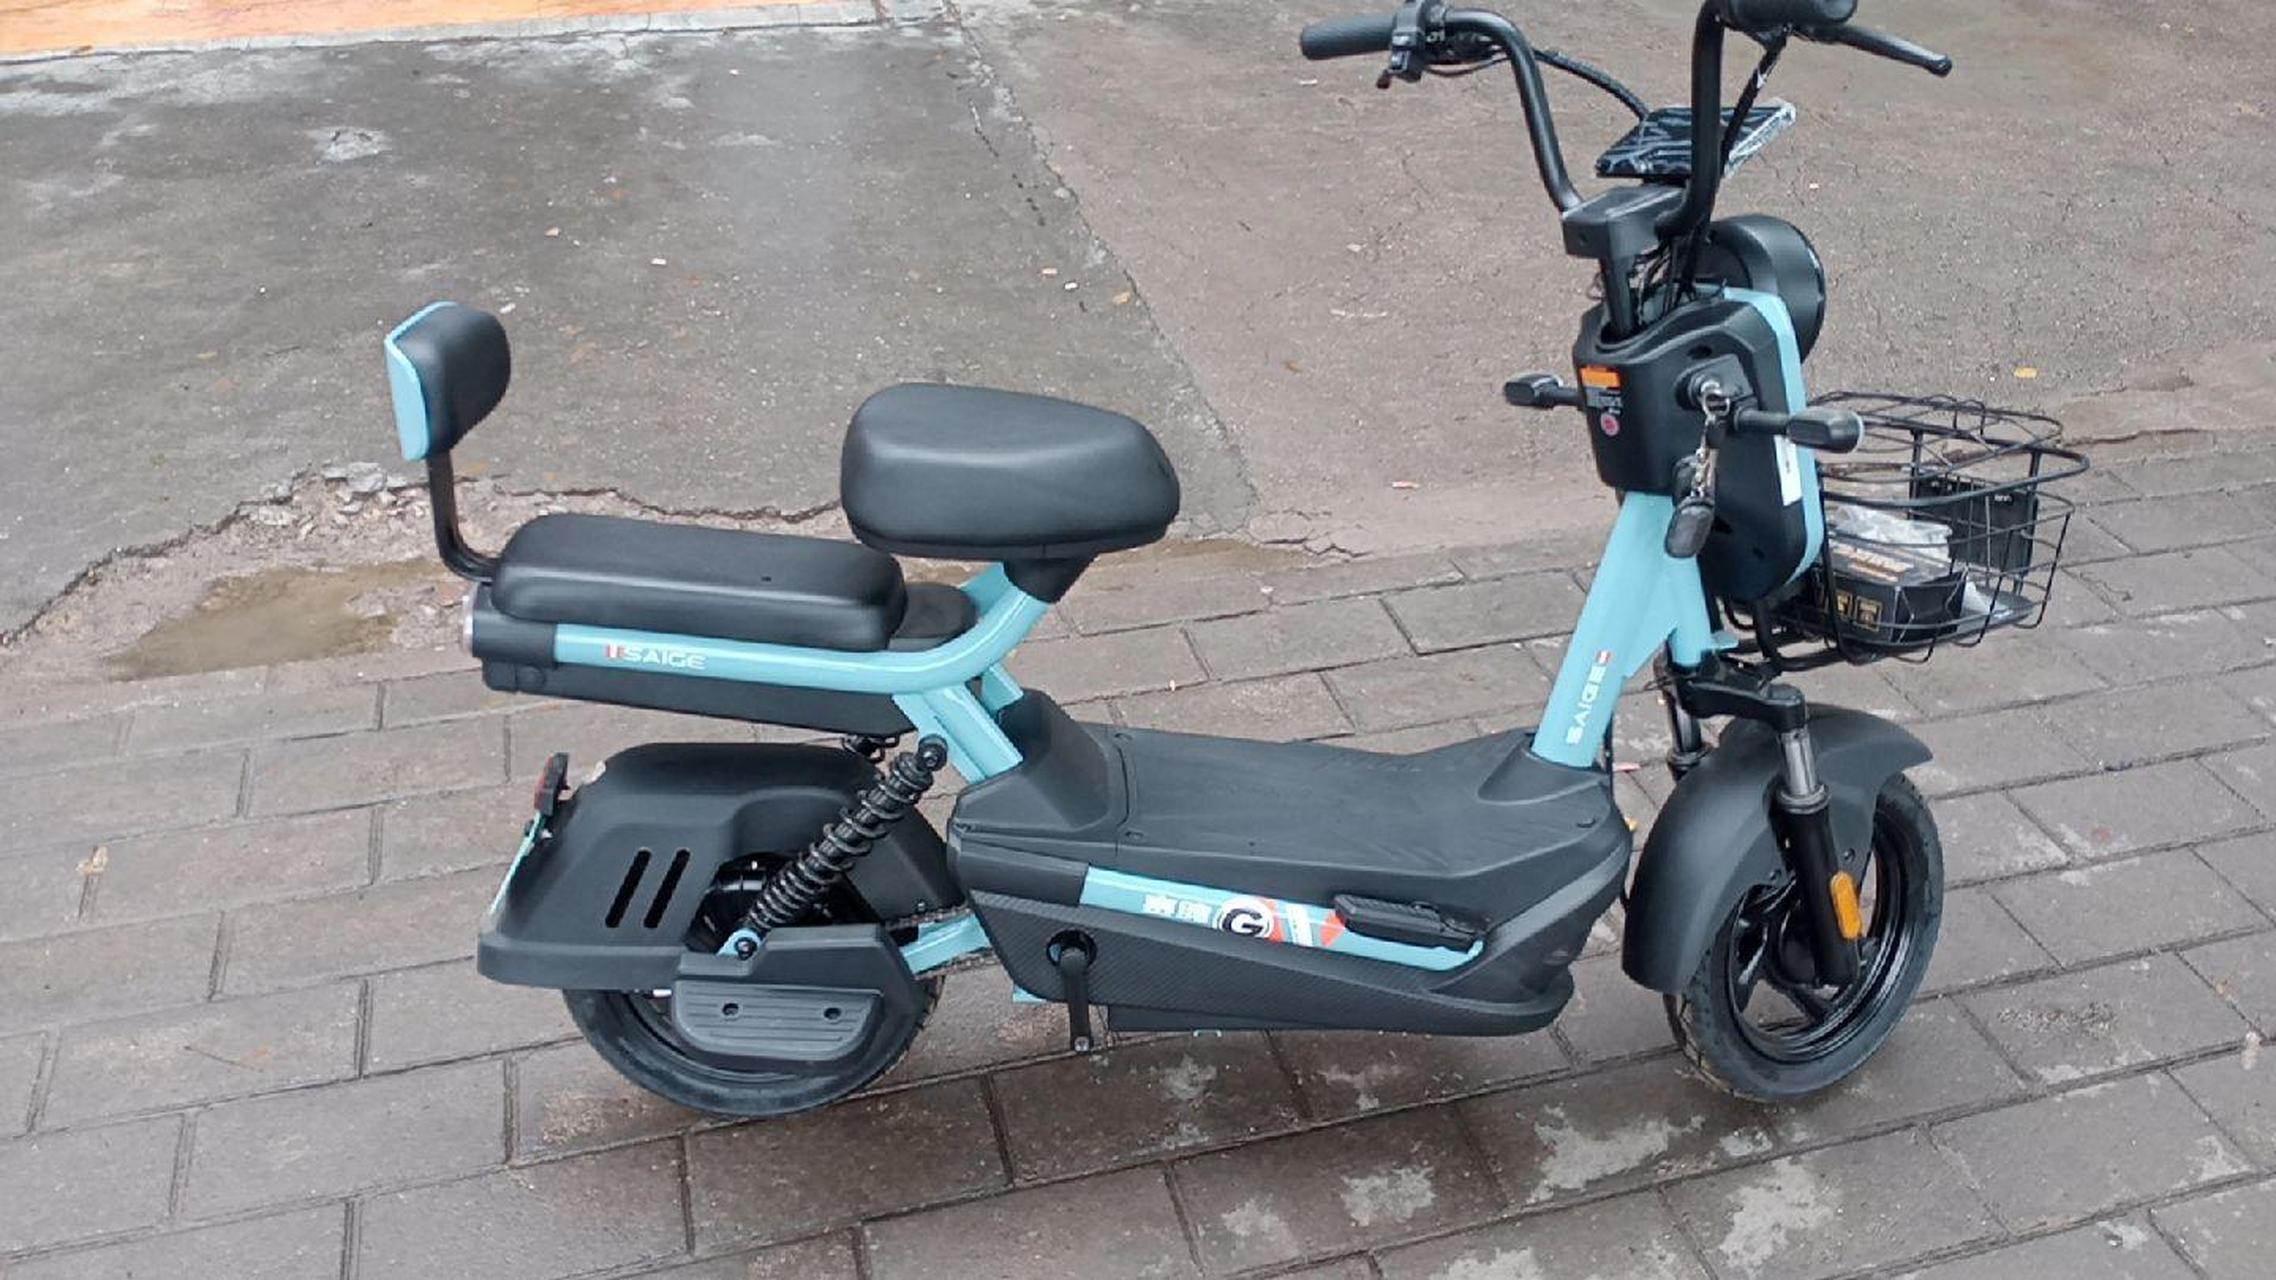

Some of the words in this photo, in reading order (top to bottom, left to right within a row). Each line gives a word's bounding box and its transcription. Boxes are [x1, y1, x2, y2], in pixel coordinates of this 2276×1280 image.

[622, 647, 707, 670] SAIGE
[1566, 664, 1607, 744] SAIGE
[1222, 908, 1264, 937] G
